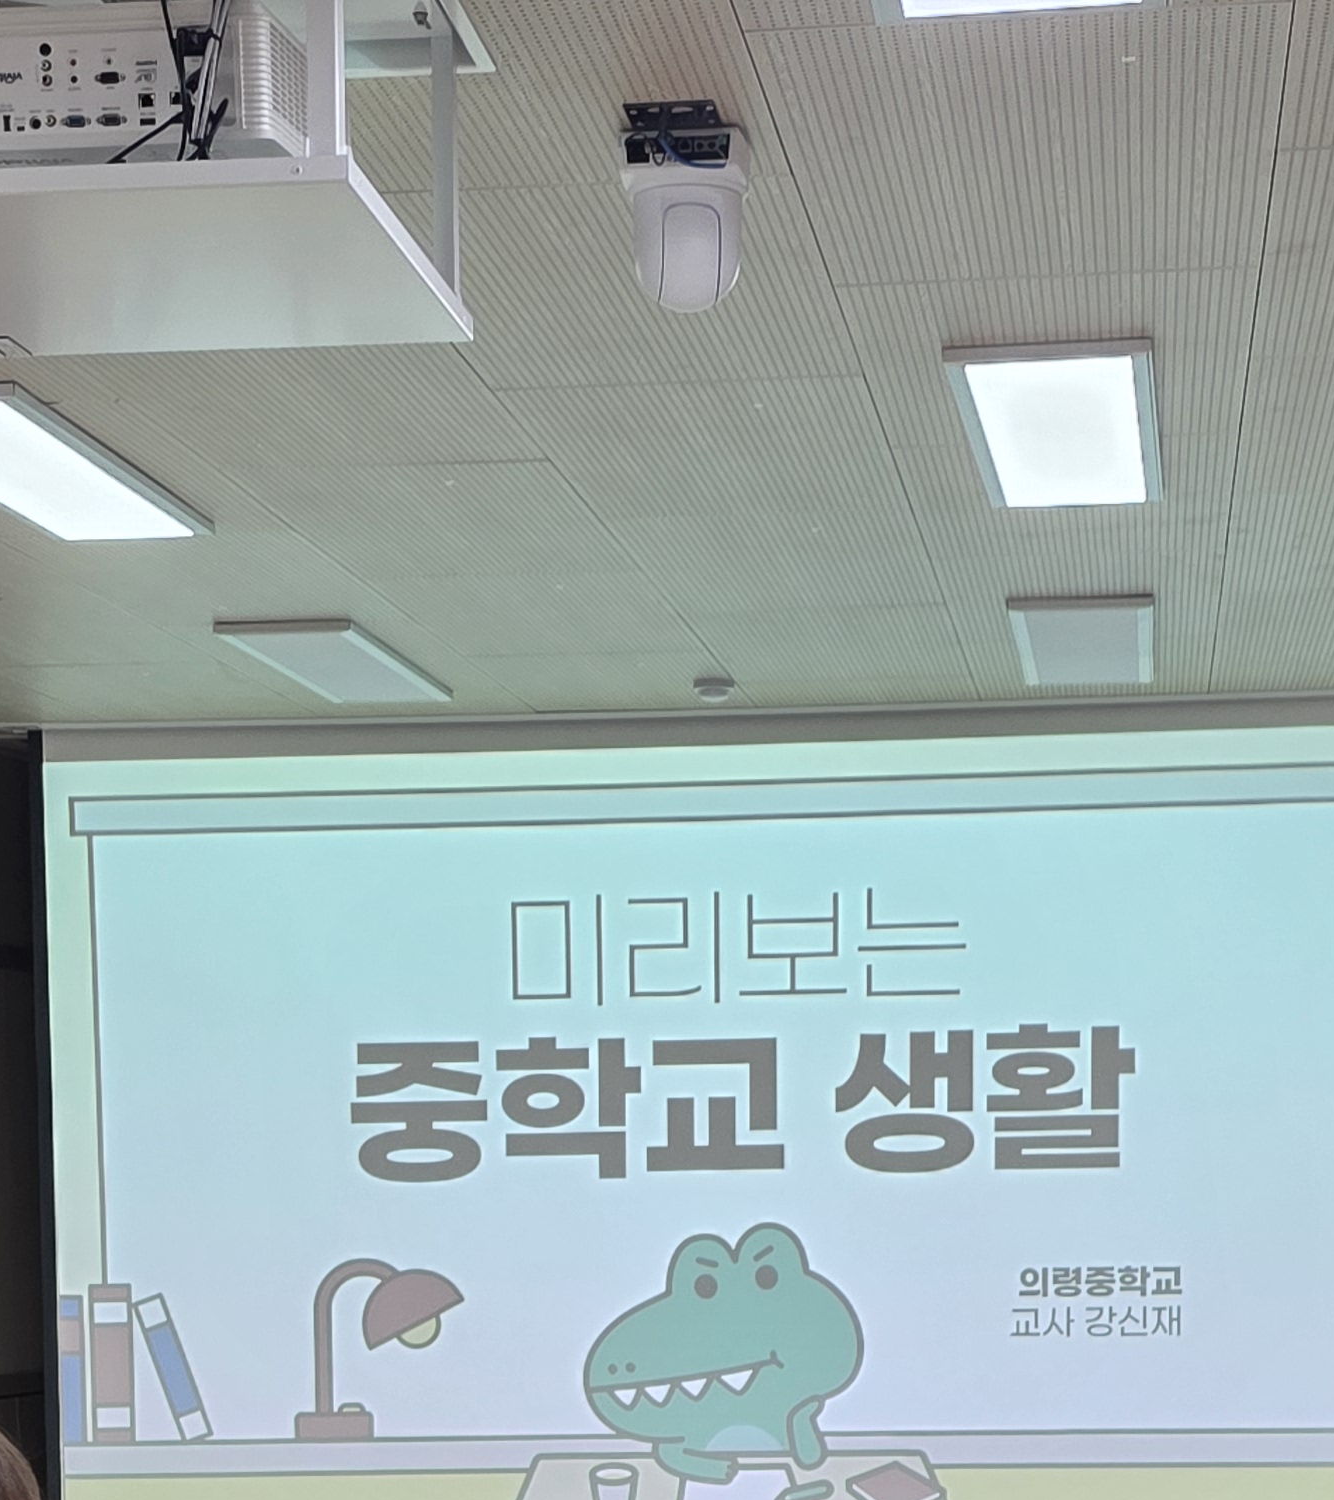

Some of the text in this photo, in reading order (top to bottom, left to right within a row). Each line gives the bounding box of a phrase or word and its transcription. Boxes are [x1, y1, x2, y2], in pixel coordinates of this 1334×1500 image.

[510, 887, 968, 1007] 미리보는
[349, 1022, 1137, 1184] 중학교 생활
[1018, 1265, 1183, 1297] 의령중학교
[1010, 1304, 1182, 1337] 교사 강신재
